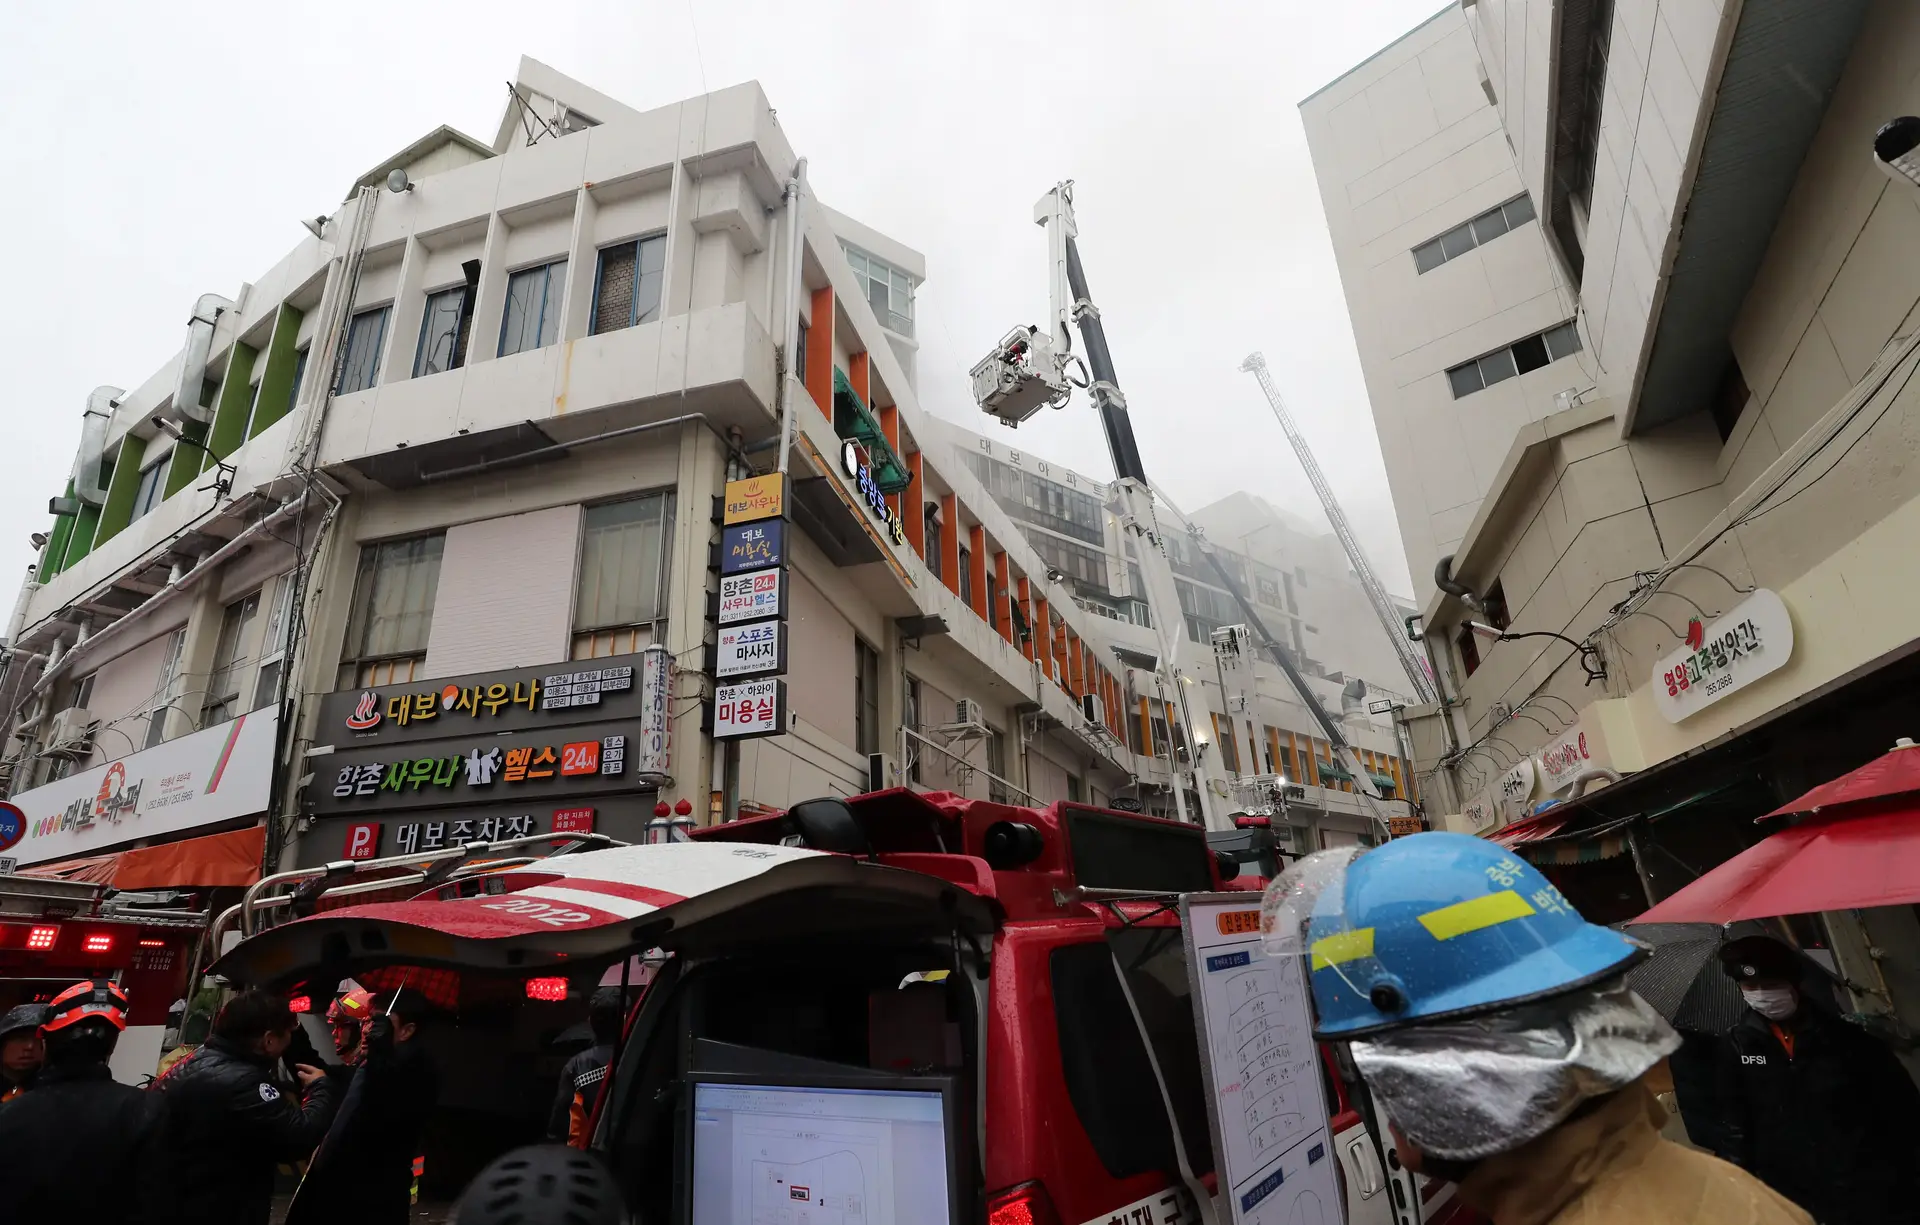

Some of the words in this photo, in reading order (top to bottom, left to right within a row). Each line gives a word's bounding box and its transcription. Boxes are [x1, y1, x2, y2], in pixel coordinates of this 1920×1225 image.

[979, 438, 1105, 498] 대보아파트
[741, 528, 765, 542] 대보
[723, 577, 753, 598] 향촌
[755, 577, 775, 591] 24시
[736, 626, 774, 645] 스포츠
[736, 641, 774, 661] 마사지
[1664, 618, 1759, 697] 영양고추방앗간
[767, 659, 776, 668] 3F
[719, 687, 736, 701] 향촌
[747, 682, 774, 696] 하와이
[387, 691, 437, 727] 대보
[455, 678, 541, 718] 사우나
[718, 695, 774, 725] 미용실
[764, 720, 773, 729] 3F
[503, 746, 556, 782] 헬스
[350, 826, 371, 857] P
[479, 899, 593, 927] 2012
[1740, 1055, 1767, 1065] DFSI
